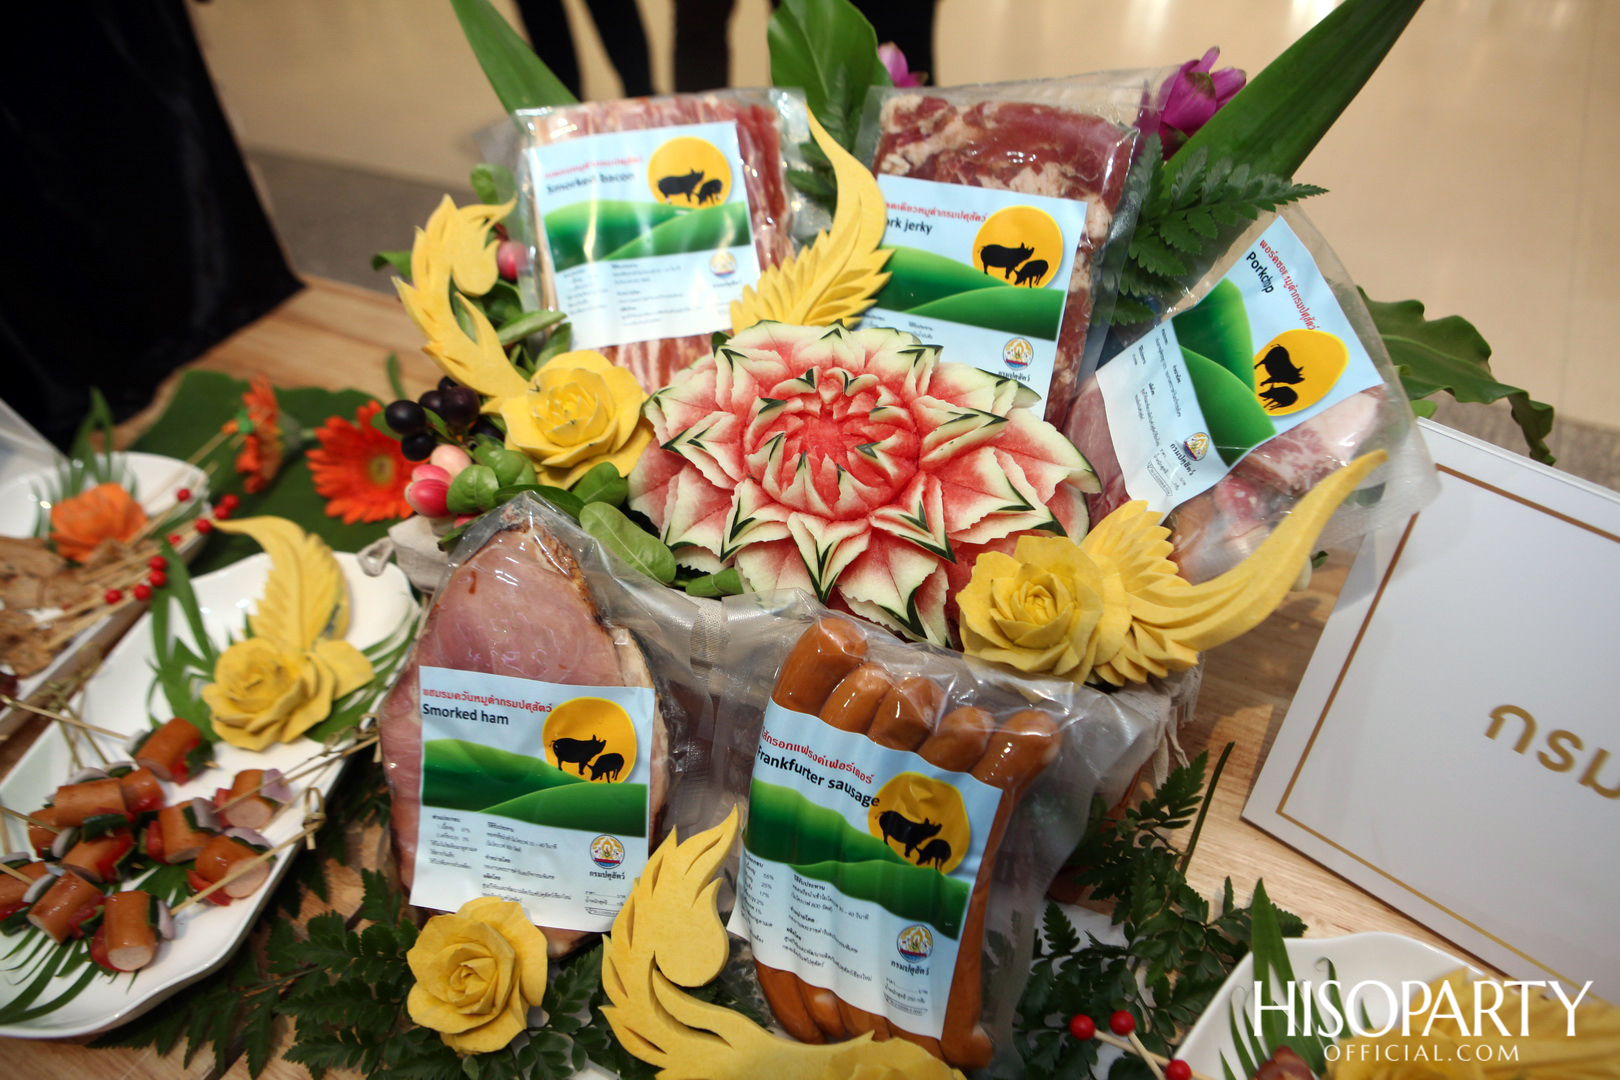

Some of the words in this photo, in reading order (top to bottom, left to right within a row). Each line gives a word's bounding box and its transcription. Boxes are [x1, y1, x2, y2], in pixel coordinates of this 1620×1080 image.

[887, 217, 902, 230] ork
[903, 219, 933, 236] jerky
[423, 703, 478, 722] Smorked
[480, 709, 510, 726] ham
[827, 779, 880, 808] sausage
